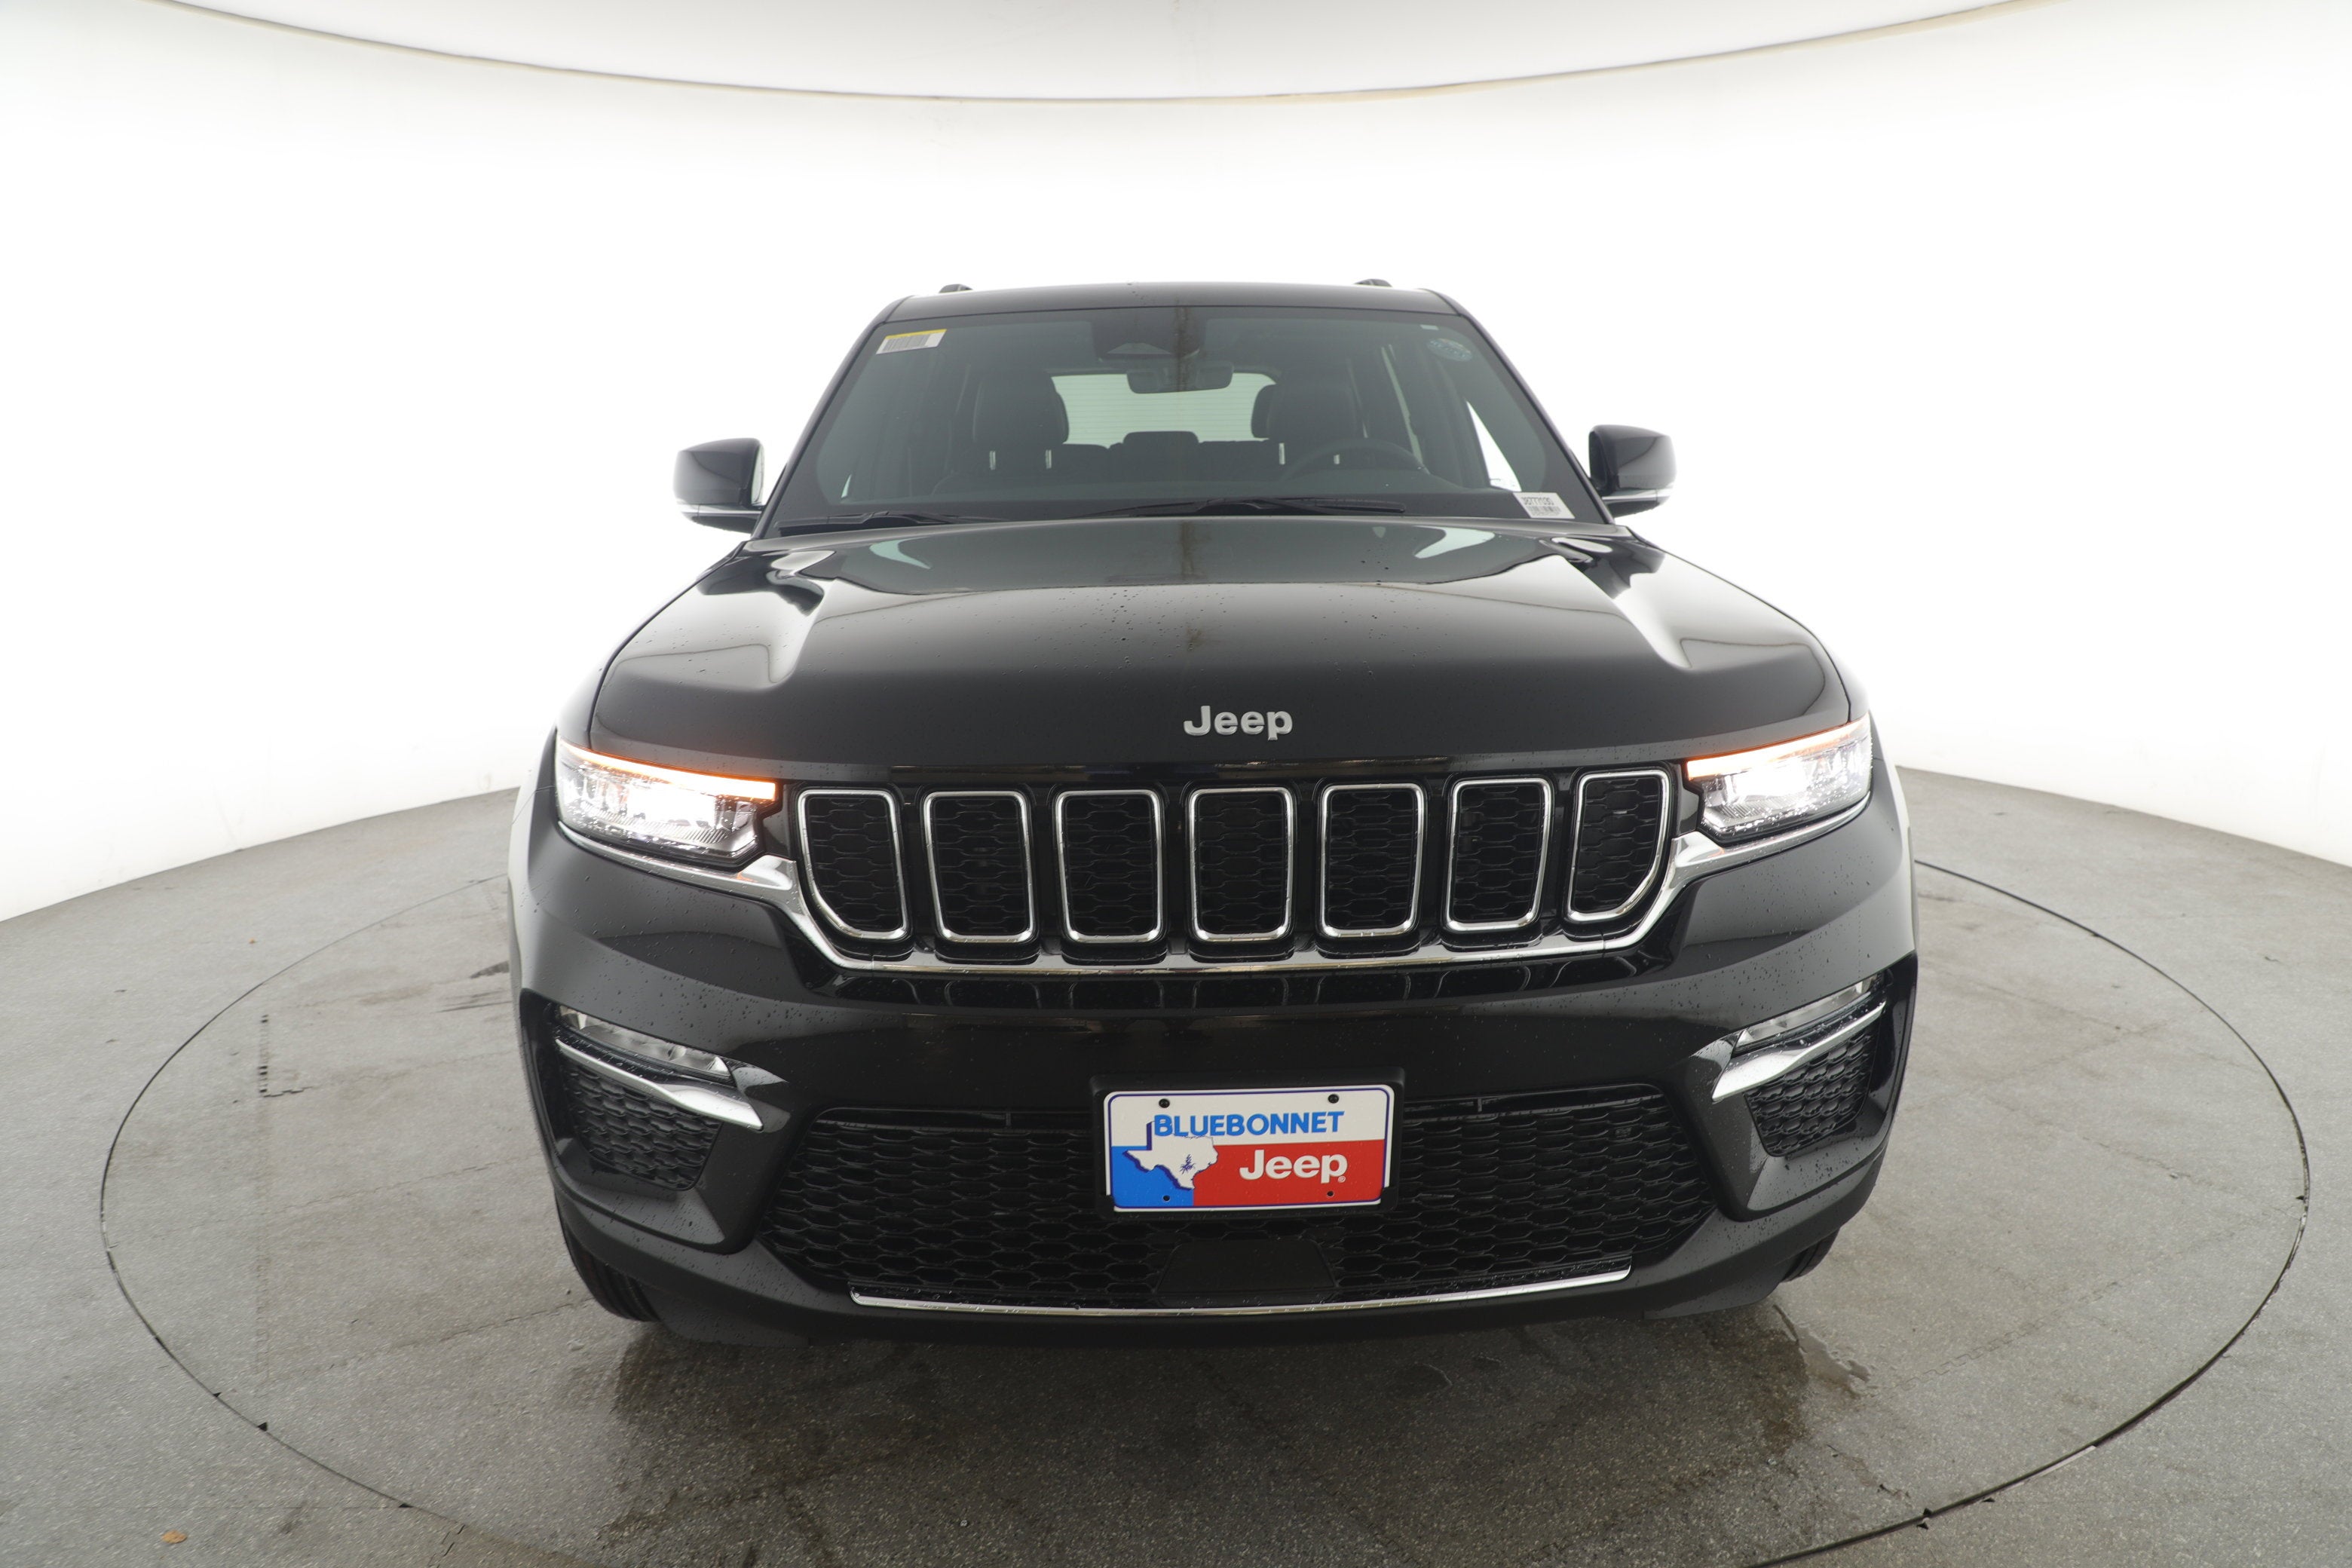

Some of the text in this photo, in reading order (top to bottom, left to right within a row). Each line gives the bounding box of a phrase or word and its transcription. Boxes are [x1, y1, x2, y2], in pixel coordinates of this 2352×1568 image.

[1184, 705, 1293, 741] Jeep
[1153, 1110, 1345, 1137] BLUEBONNET
[1239, 1150, 1348, 1184] Jeep
